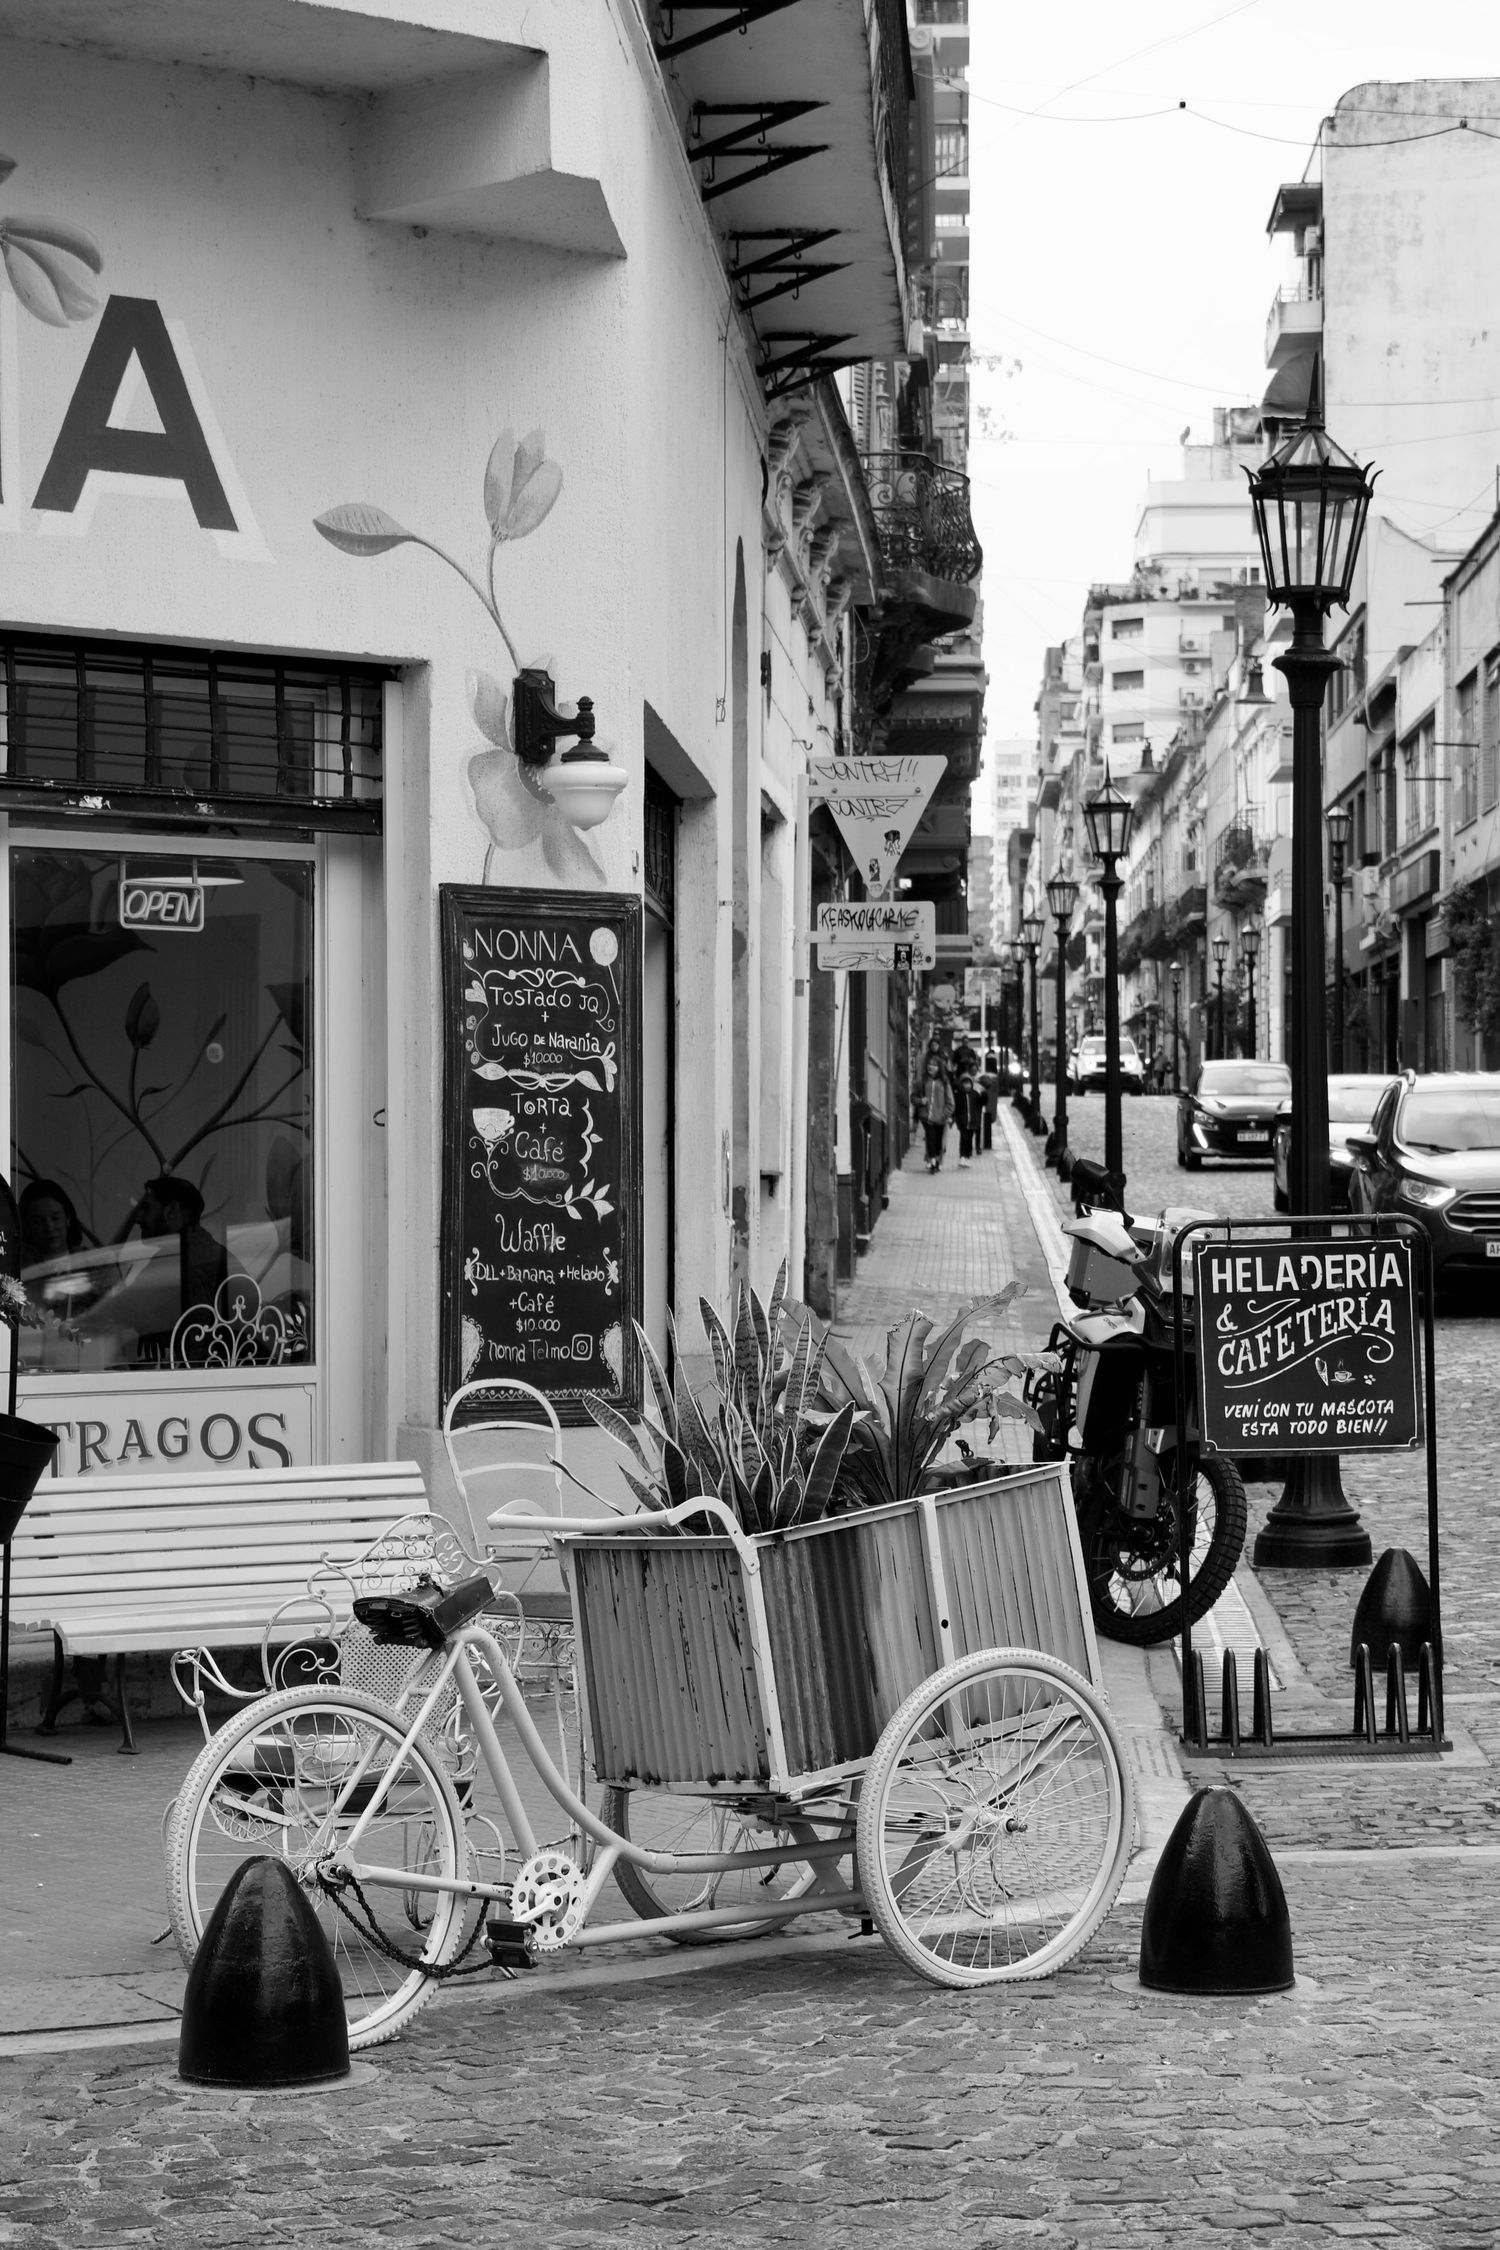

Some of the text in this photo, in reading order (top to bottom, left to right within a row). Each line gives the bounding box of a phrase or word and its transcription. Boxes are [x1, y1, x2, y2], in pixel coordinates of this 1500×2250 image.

[125, 889, 200, 923] OPEN
[475, 928, 582, 963] NONNA
[579, 994, 599, 1014] JQ
[533, 1036, 546, 1045] DE
[549, 1032, 600, 1053] Naranja
[515, 1131, 565, 1163] Café
[495, 1213, 566, 1253] Waffle
[1211, 1246, 1404, 1294] HELADERÍA
[1216, 1303, 1239, 1332] &
[1217, 1292, 1396, 1376] CAFETERÍA
[1263, 1402, 1290, 1418] CON
[1296, 1402, 1314, 1416] TU
[1321, 1399, 1394, 1417] MASCOTA
[1242, 1418, 1387, 1437] ESTA TODO BIEN!!
[40, 1412, 290, 1478] TRAGOS
